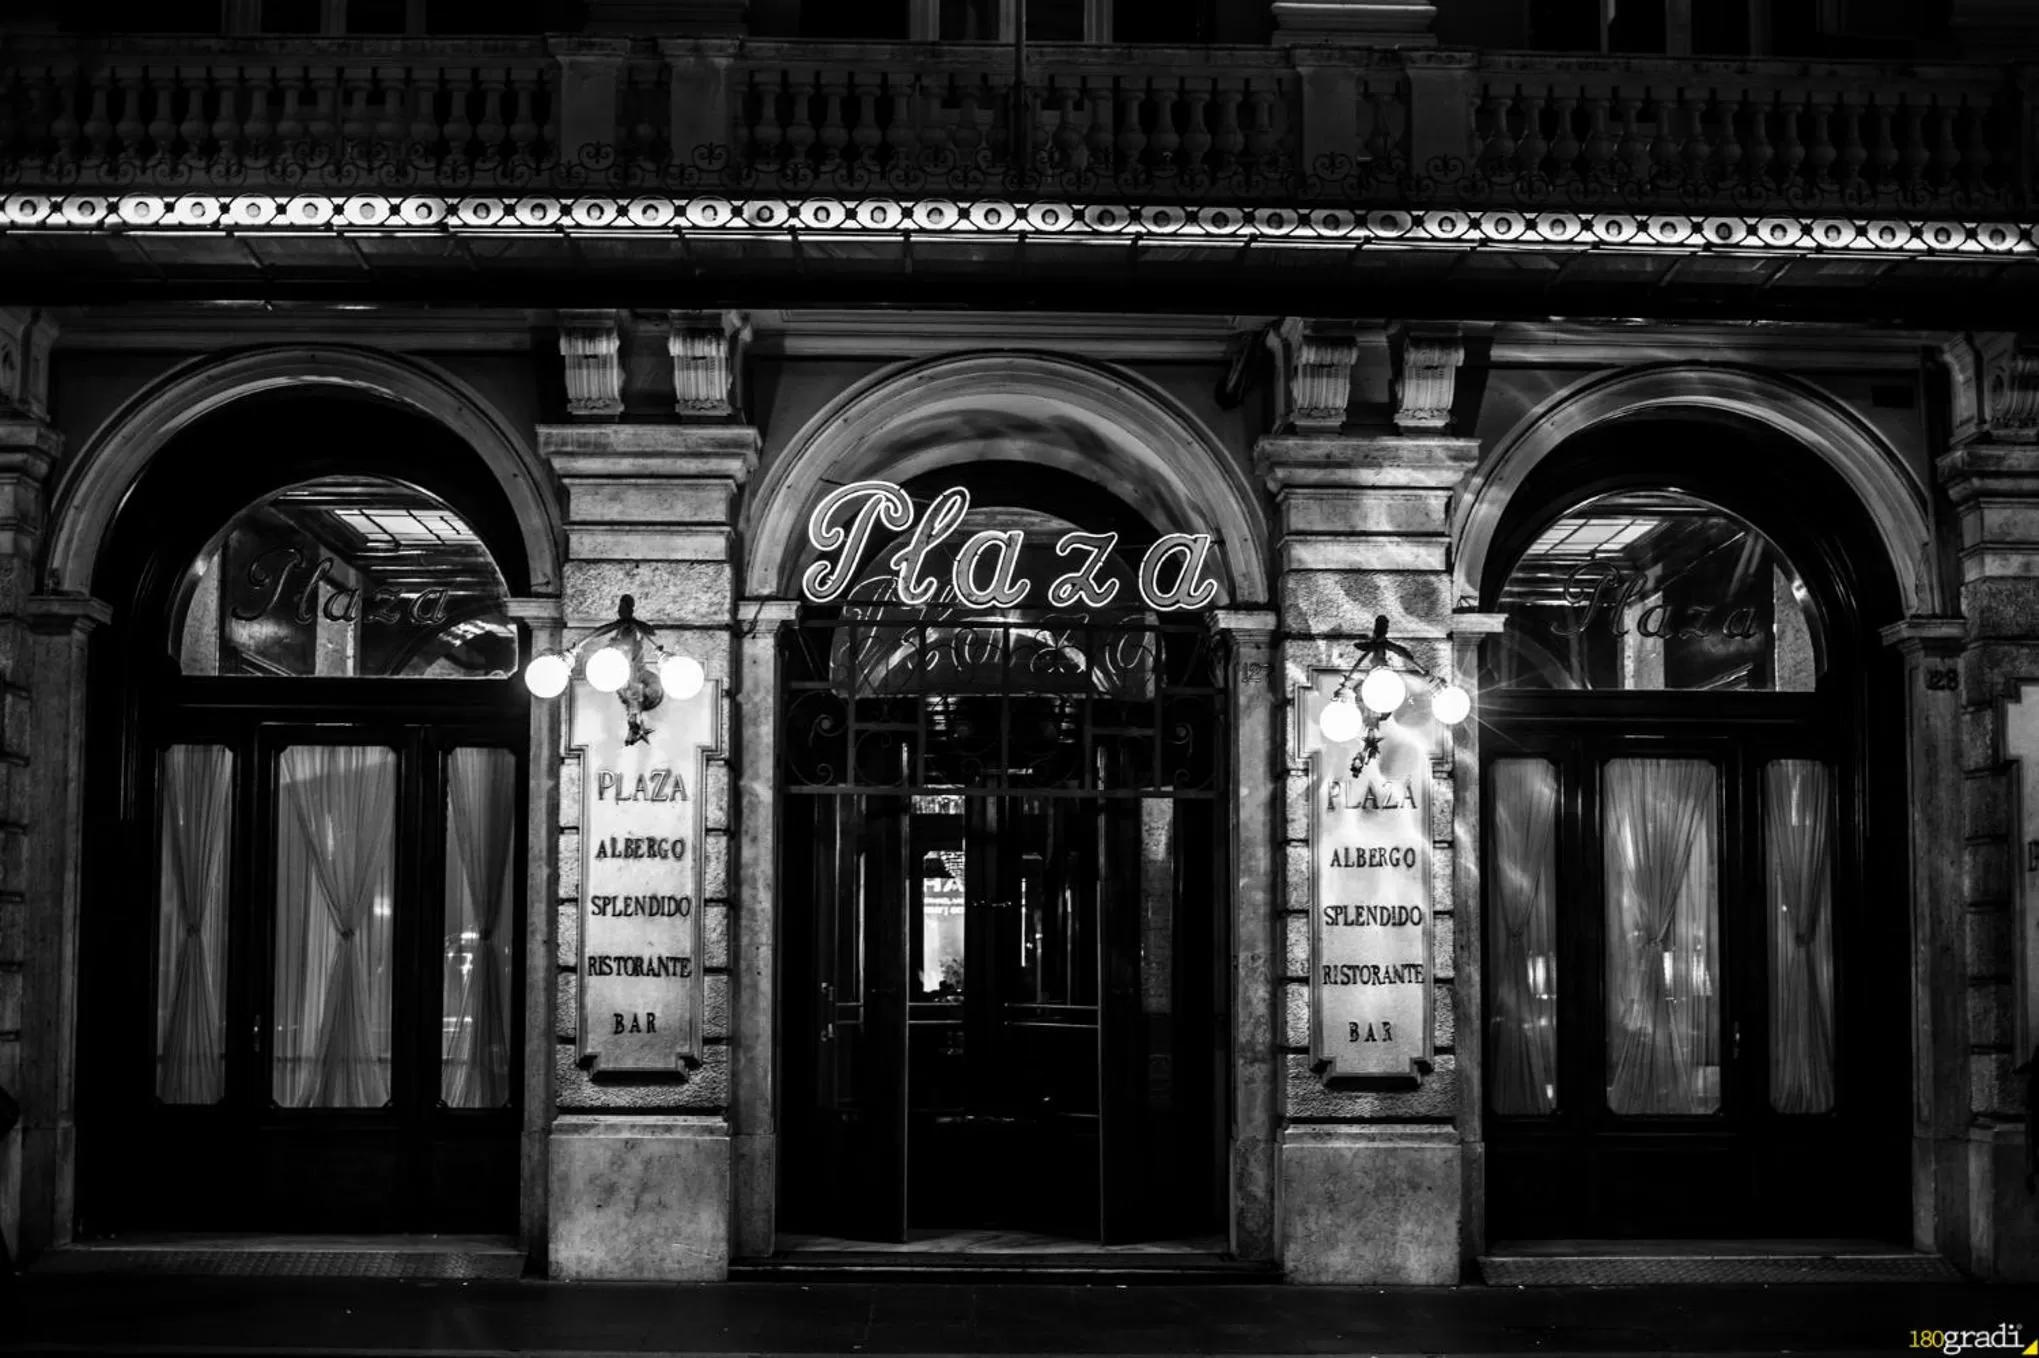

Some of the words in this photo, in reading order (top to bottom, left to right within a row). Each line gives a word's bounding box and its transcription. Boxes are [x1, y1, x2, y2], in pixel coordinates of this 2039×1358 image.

[803, 481, 1217, 610] Plaza
[231, 545, 449, 624] Plaza
[597, 768, 689, 803] PLAZA
[1327, 778, 1418, 811] PLAZA
[595, 836, 686, 860] ALBERGO
[1330, 847, 1417, 869] ALBERGO
[591, 895, 692, 918] SPLENDIDO
[1323, 905, 1423, 927] SPLENDIDO
[587, 955, 692, 978] RISTORANTE
[1322, 963, 1425, 986] RISTORANTE
[613, 1012, 657, 1035] BAR
[1348, 1021, 1393, 1043] BAR
